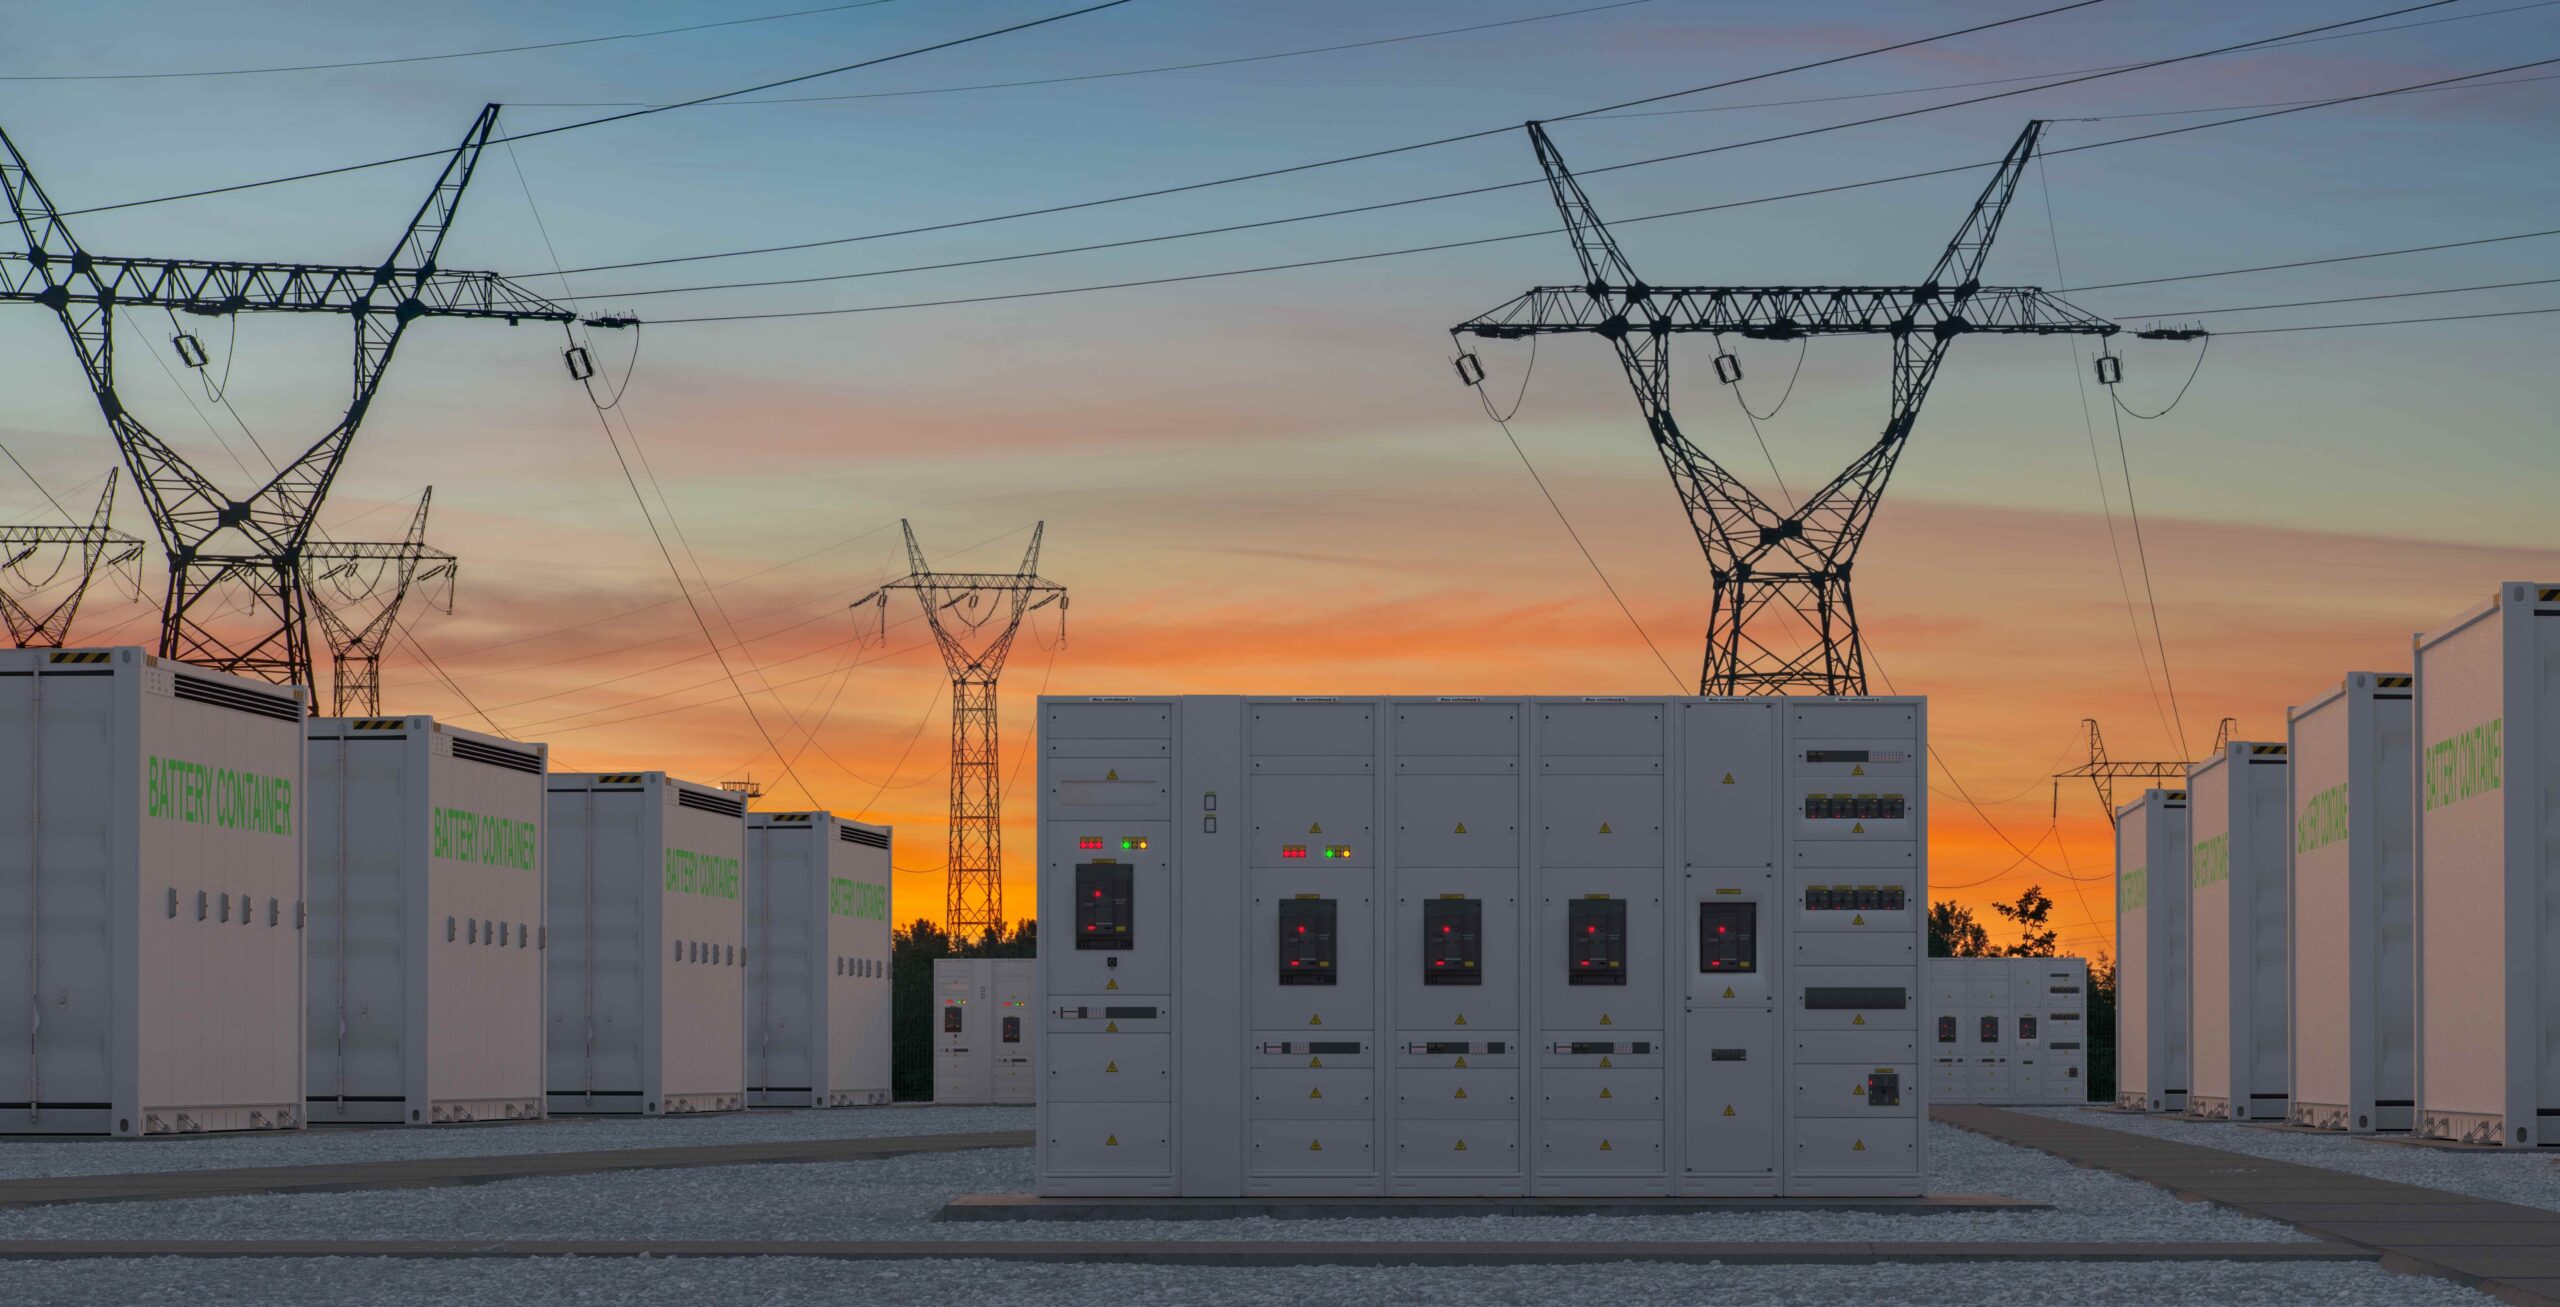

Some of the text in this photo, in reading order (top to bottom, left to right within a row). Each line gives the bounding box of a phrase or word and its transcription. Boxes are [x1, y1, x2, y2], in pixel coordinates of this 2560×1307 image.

[148, 755, 293, 836] BATTERY CONTAINER
[2426, 738, 2457, 812] BATTERY
[433, 807, 537, 871] BATTERY CONTAINER
[664, 848, 740, 900] BATTERY CONTAINER
